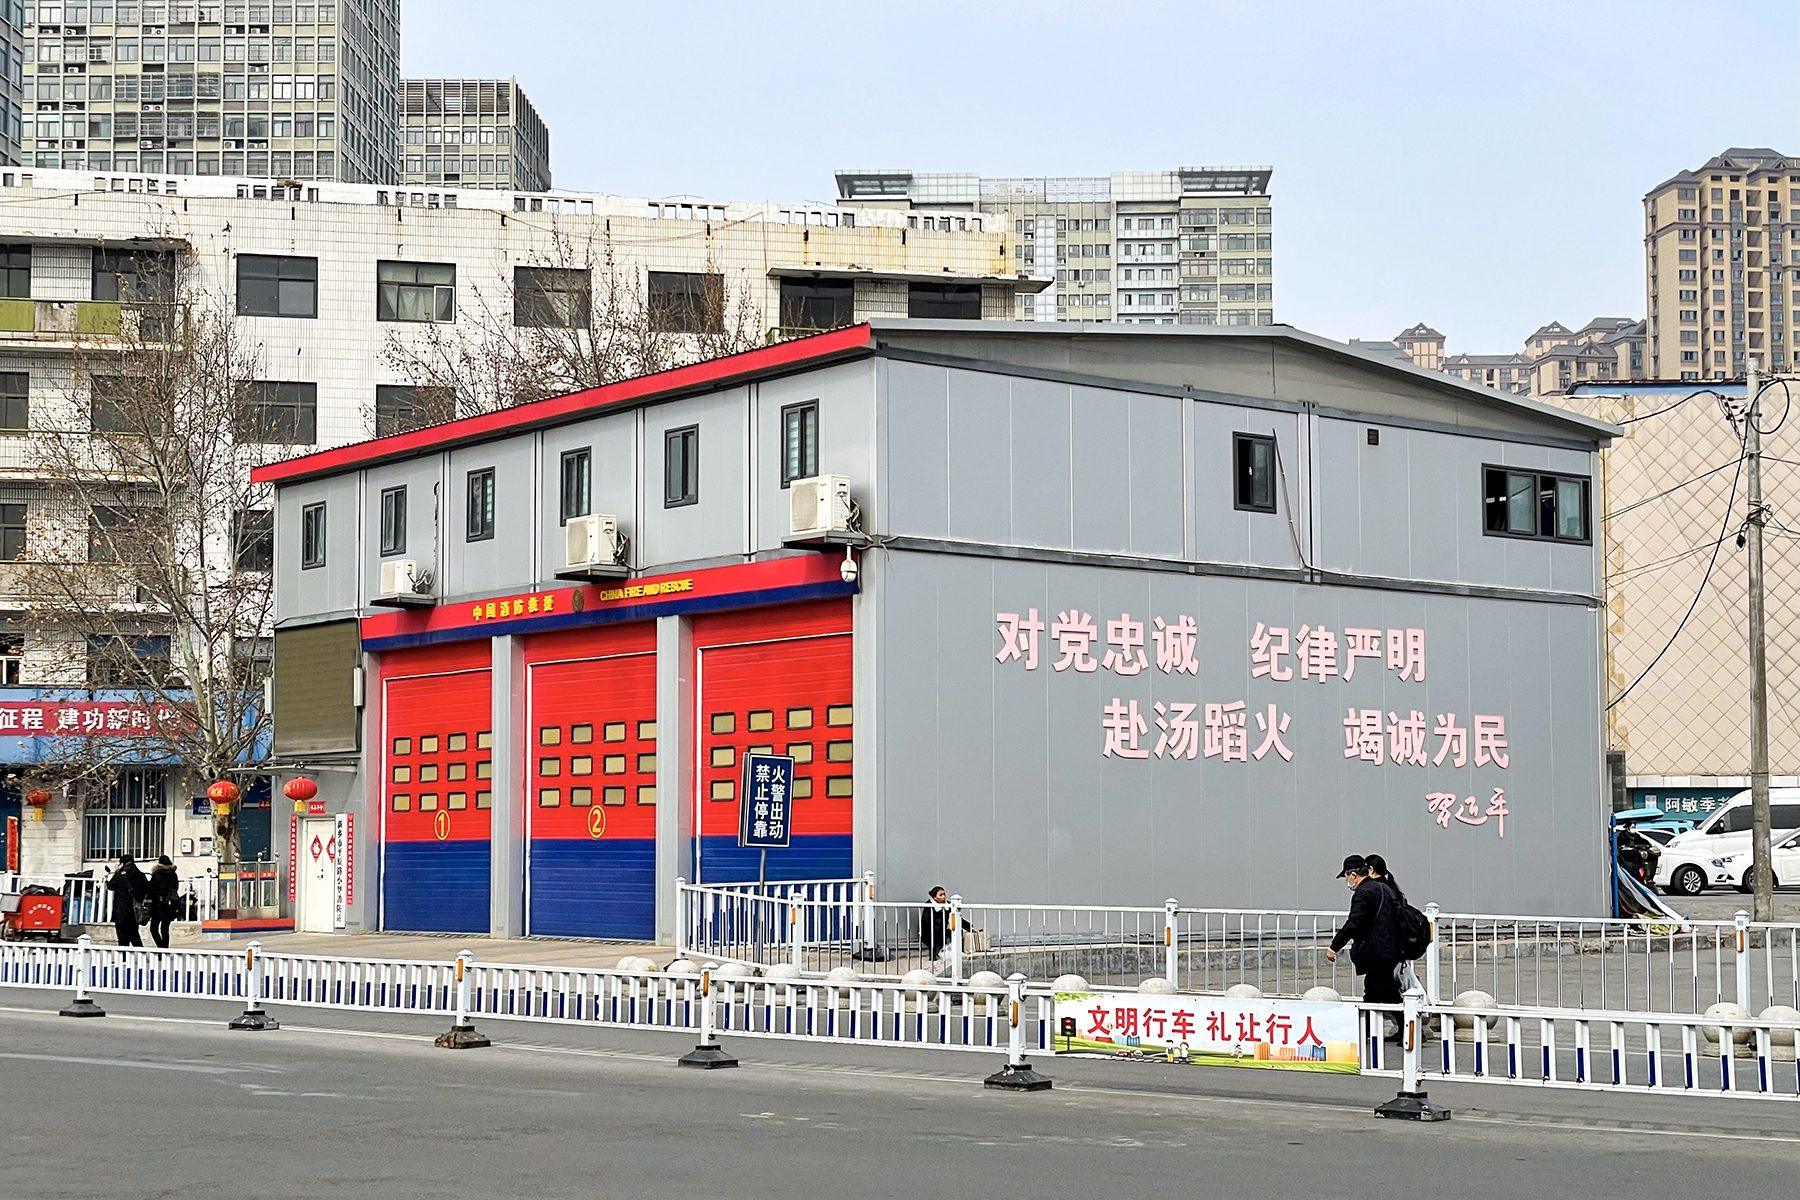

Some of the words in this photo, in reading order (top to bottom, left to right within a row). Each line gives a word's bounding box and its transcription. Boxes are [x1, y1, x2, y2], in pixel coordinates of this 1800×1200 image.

[472, 594, 555, 621] 中国消防救援
[600, 588, 624, 601] CHINA
[624, 585, 645, 598] FIRE
[660, 578, 694, 594] RESCUE
[995, 607, 1200, 676] 对党忠诚
[1250, 621, 1427, 684] 纪律严明
[0, 707, 44, 730] 征程
[1102, 697, 1294, 762] 赴汤蹈火
[1342, 707, 1511, 769] 竭诚为民
[753, 763, 771, 838] 禁止停靠
[769, 765, 786, 839] 火警出动
[1087, 1004, 1196, 1041] 文明行车
[1205, 1011, 1324, 1047] 礼让行人
